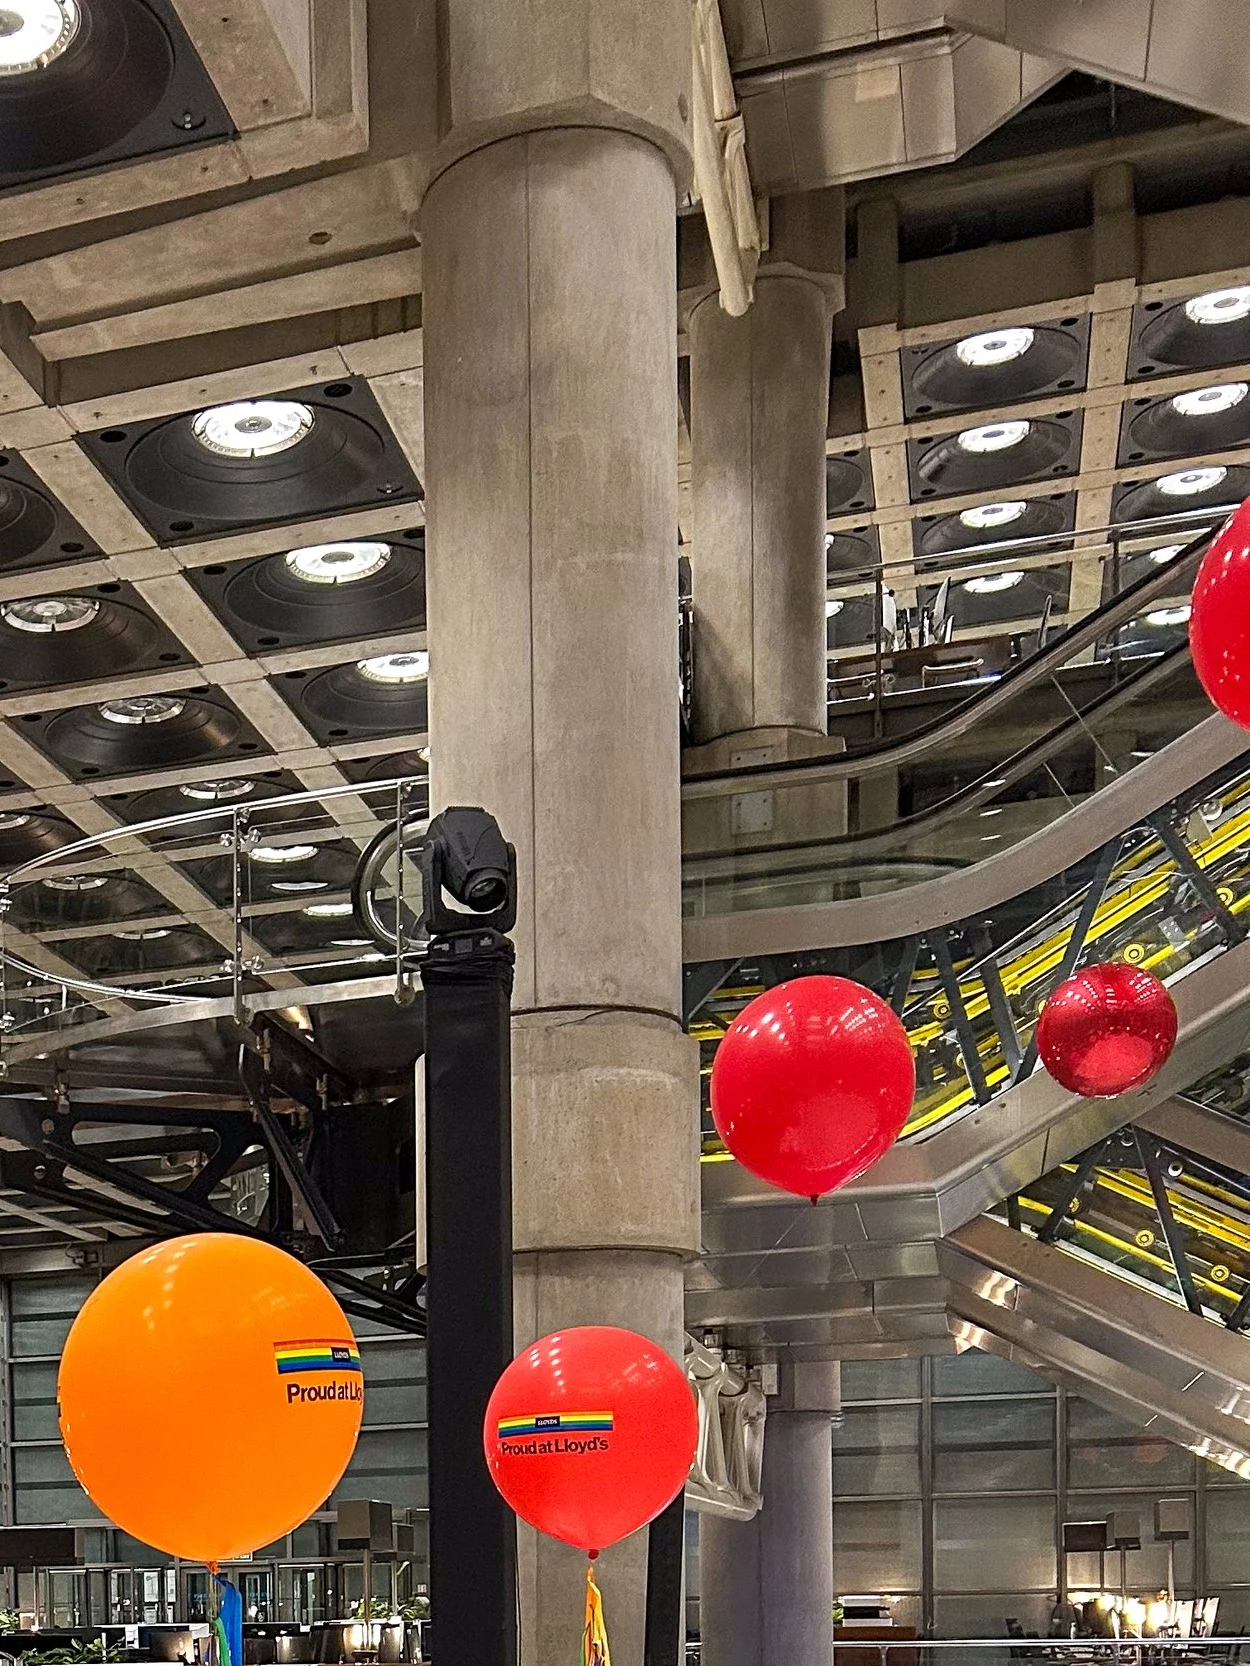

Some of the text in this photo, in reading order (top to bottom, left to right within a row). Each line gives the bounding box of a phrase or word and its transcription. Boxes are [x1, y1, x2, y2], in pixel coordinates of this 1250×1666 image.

[286, 1381, 336, 1404] Proud
[337, 1381, 349, 1400] at
[501, 1437, 609, 1456] Proud at Lloyd's
